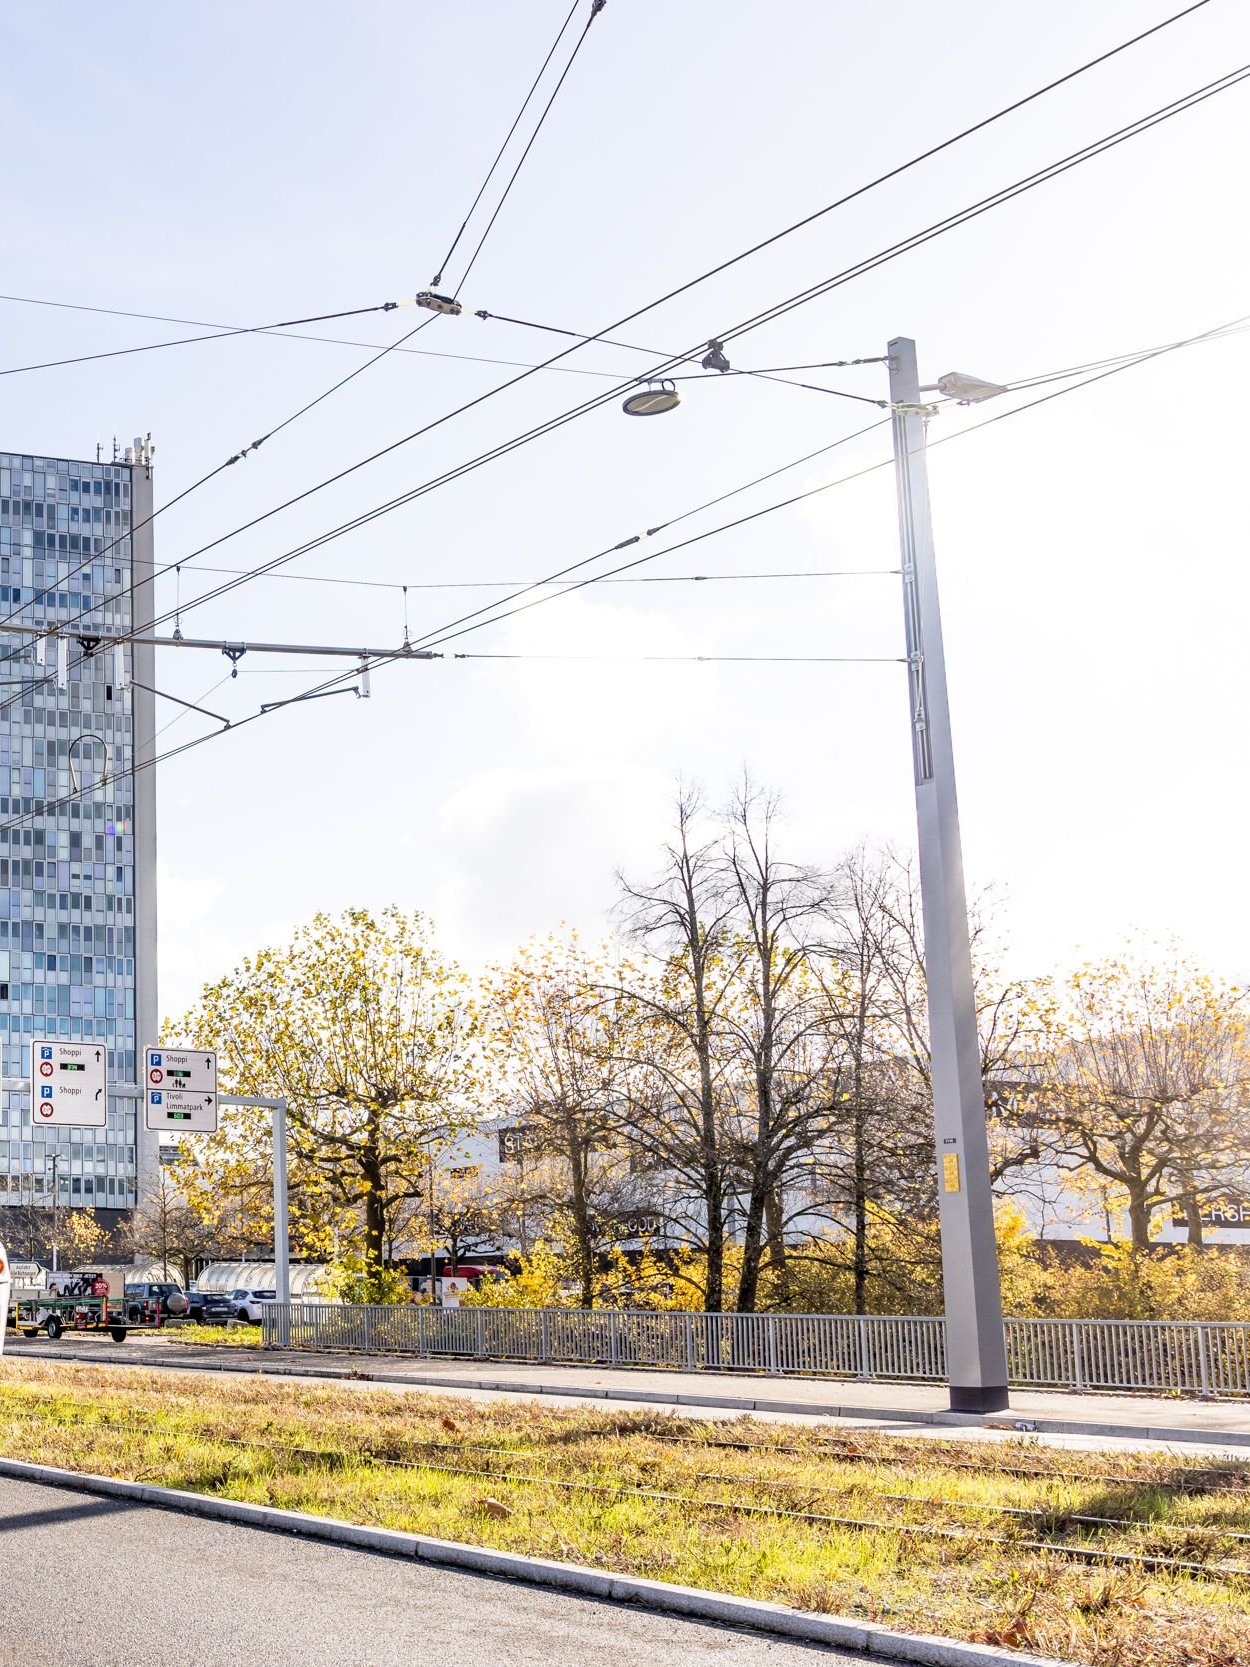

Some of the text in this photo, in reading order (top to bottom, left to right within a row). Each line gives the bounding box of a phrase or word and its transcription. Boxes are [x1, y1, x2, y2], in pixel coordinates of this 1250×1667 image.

[59, 1048, 82, 1057] Shoppi
[166, 1055, 188, 1064] Shoppi
[59, 1086, 82, 1096] Shoppi
[166, 1092, 183, 1100] Tivoli
[166, 1102, 203, 1111] Limmatpark
